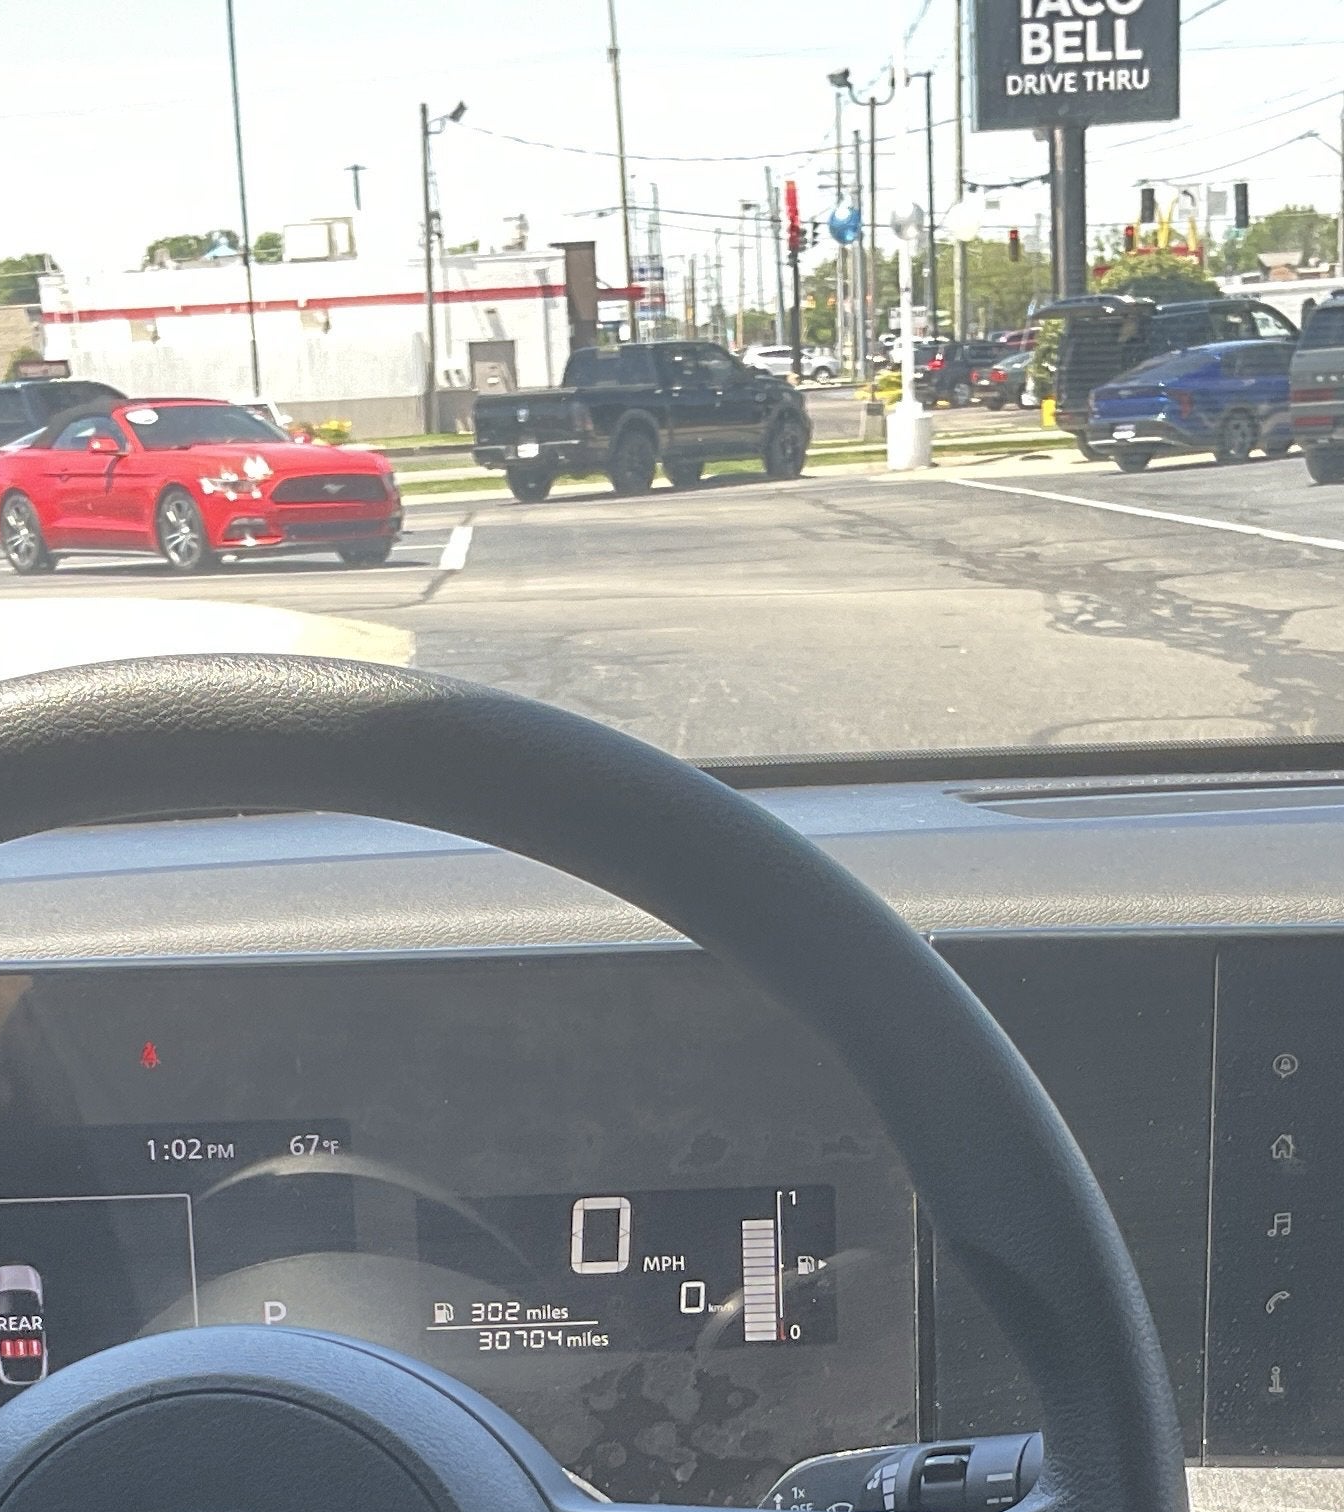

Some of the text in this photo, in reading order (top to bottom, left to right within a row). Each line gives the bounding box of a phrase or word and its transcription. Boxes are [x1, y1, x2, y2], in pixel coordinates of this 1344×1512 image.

[1020, 19, 1142, 65] BELL
[1006, 68, 1150, 96] DRIVE THRU
[147, 1138, 203, 1161] 1:02
[207, 1143, 234, 1159] PM
[570, 1196, 632, 1275] 0
[643, 1255, 685, 1273] MPH
[680, 1281, 706, 1314] 0
[264, 1302, 287, 1325] P
[471, 1301, 569, 1322] 302 miles
[479, 1329, 609, 1350] 30704 miles
[791, 1486, 805, 1499] 1x
